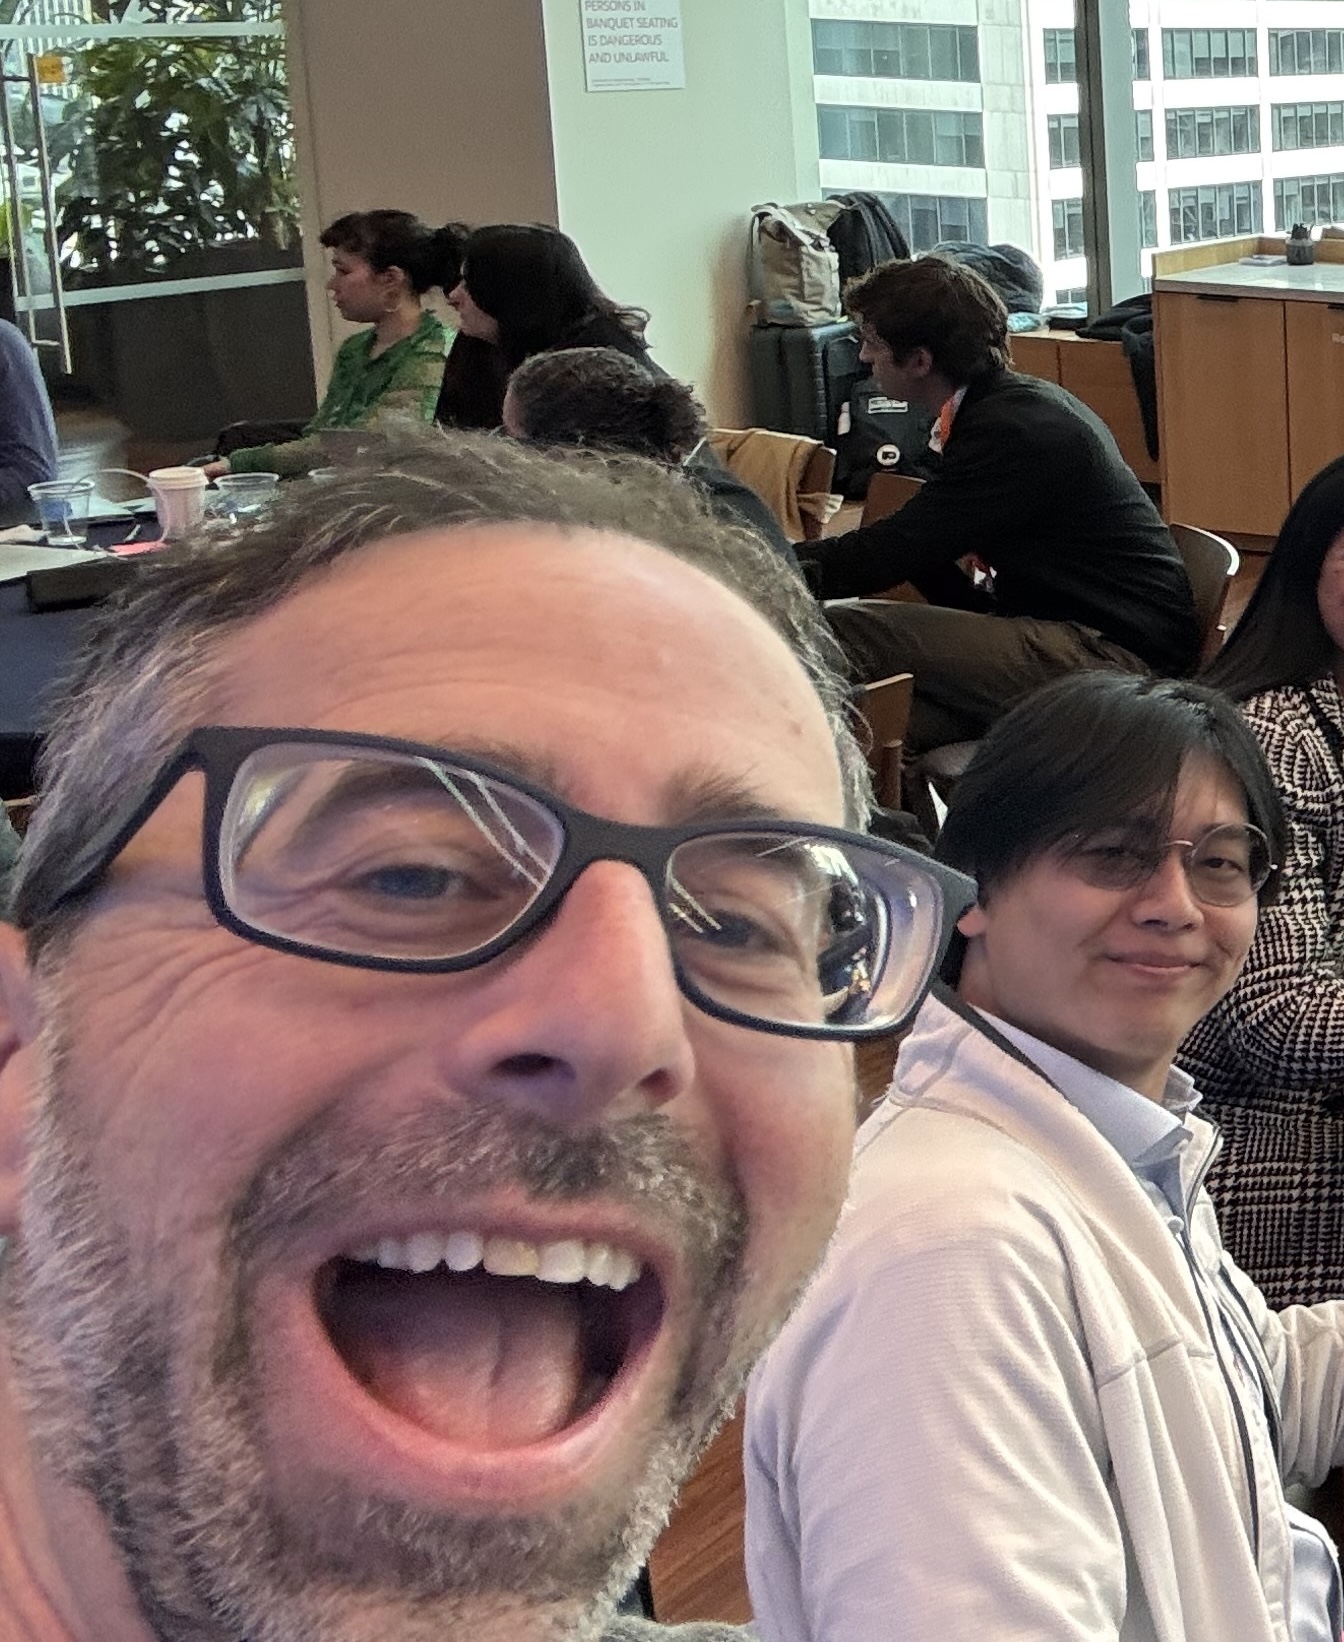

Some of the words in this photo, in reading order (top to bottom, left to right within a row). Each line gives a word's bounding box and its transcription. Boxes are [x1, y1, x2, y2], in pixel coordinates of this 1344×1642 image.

[584, 1, 631, 12] PERSONS
[634, 0, 645, 11] IN
[586, 17, 635, 30] BANQUET
[637, 17, 678, 28] SEATING
[588, 35, 598, 46] IS
[599, 34, 663, 46] DANGEROUS
[589, 52, 612, 63] AND
[614, 51, 670, 63] UNLAWFUL
